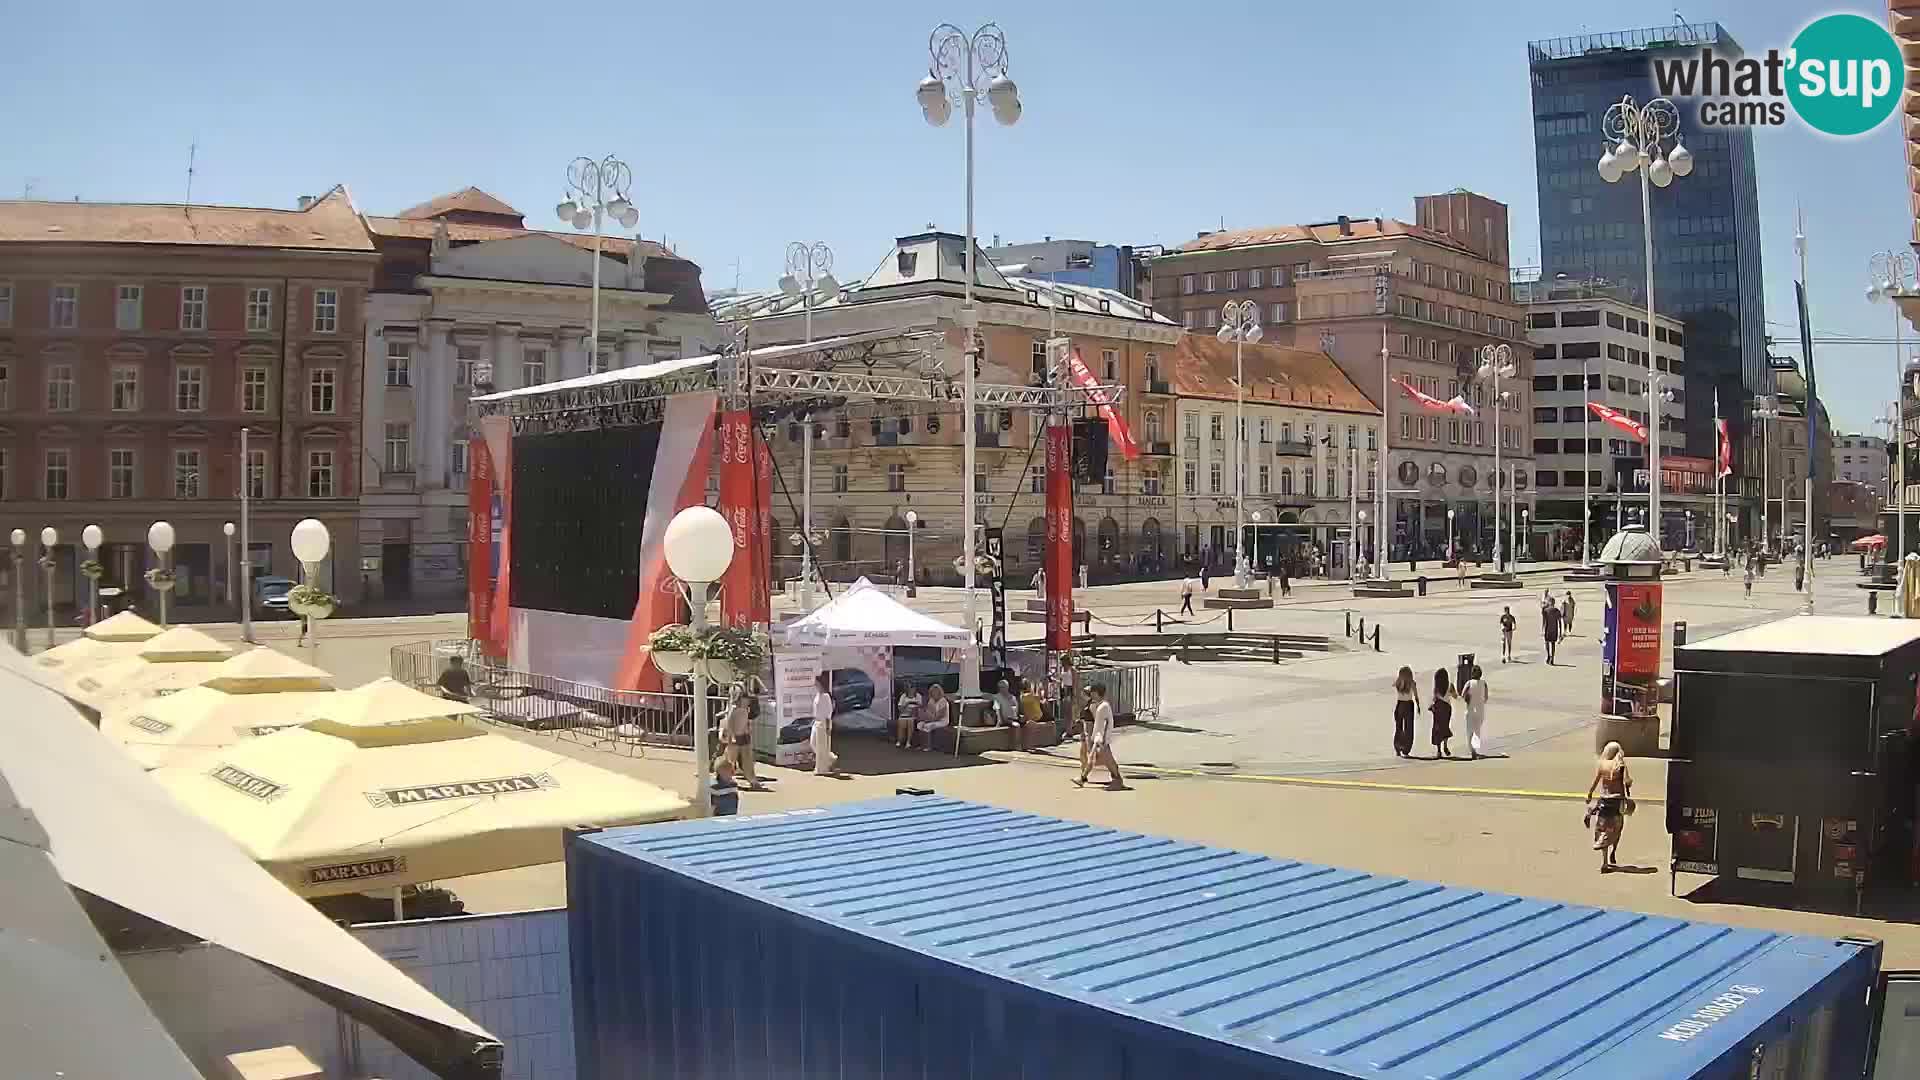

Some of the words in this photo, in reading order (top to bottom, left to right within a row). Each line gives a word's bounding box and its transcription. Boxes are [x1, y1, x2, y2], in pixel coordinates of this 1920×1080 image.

[734, 421, 748, 464] Coca-Cola
[734, 504, 747, 548] Coca-Cola
[397, 777, 531, 803] MARASKA
[314, 862, 392, 881] MARASKA
